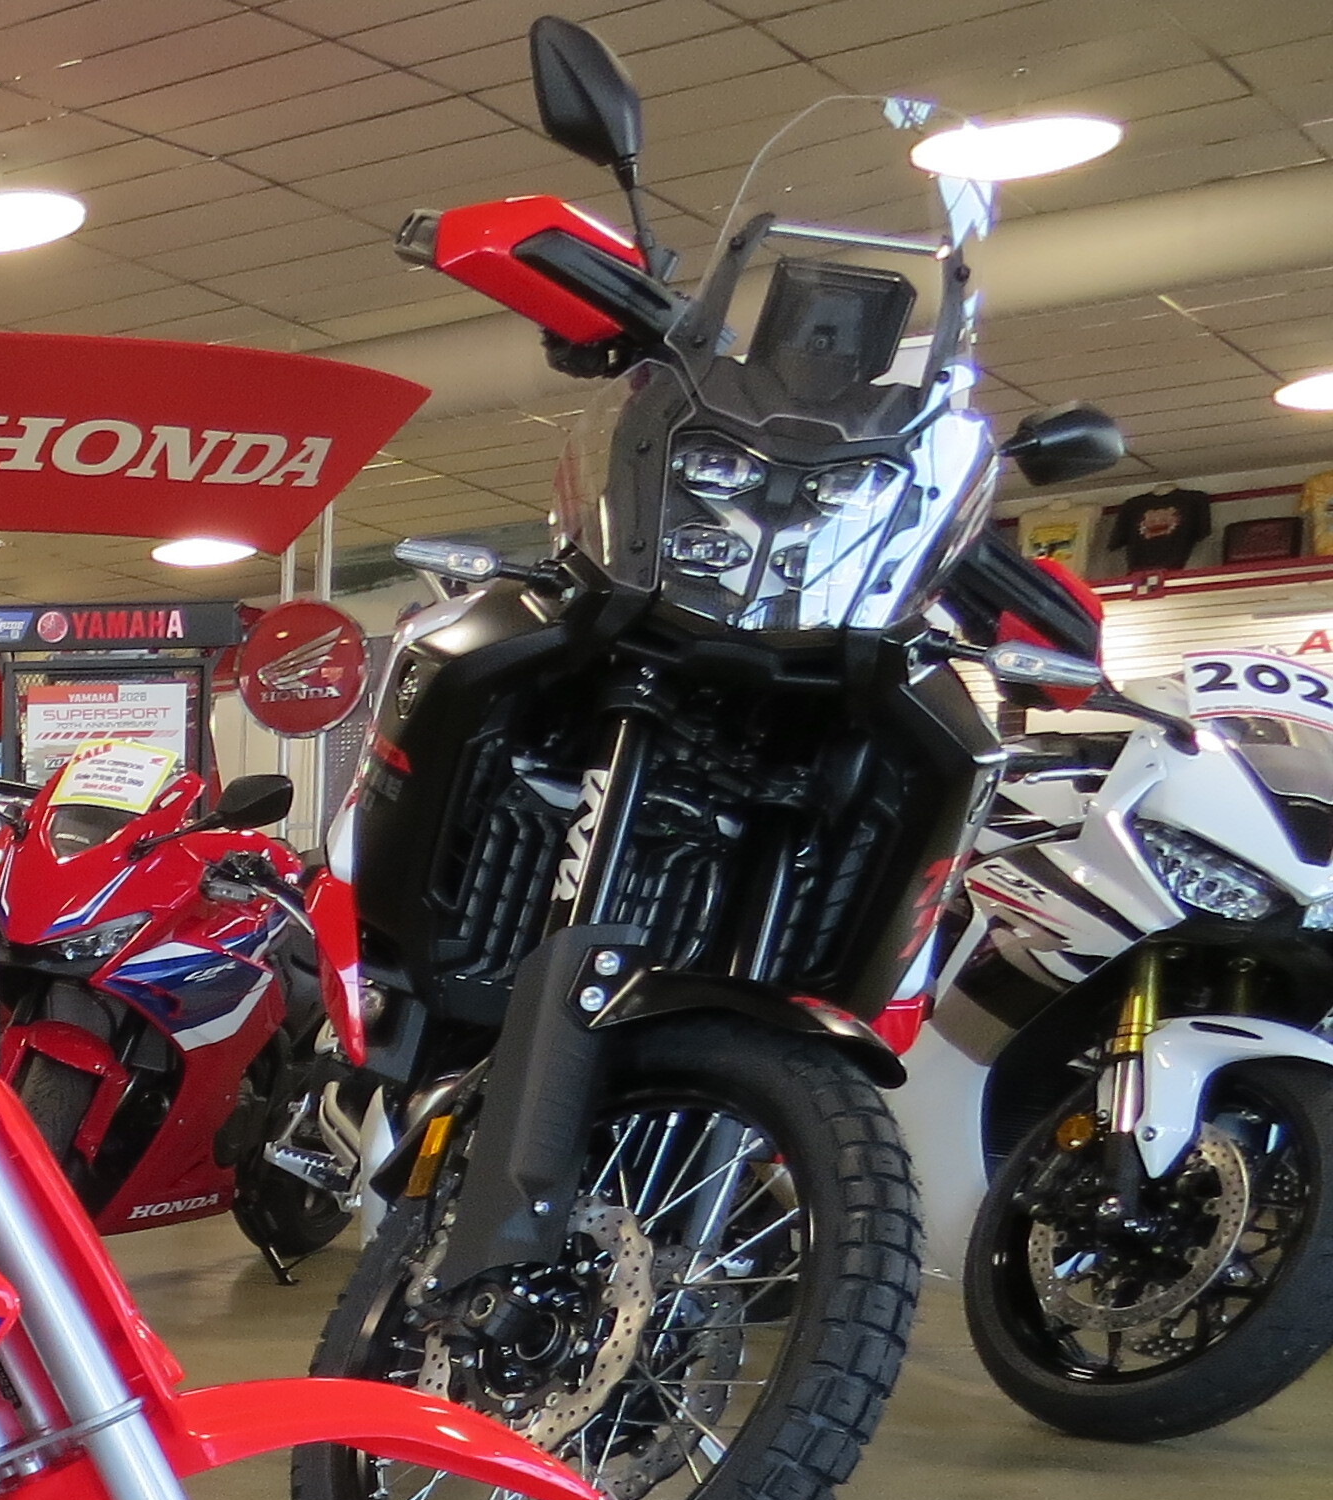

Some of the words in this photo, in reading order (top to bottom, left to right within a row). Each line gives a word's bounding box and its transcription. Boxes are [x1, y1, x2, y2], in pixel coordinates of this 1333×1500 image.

[72, 610, 185, 639] YAMAHA
[259, 686, 342, 703] HONDA
[1192, 660, 1333, 711] 202
[67, 693, 116, 703] YAMAHA
[42, 707, 171, 722] SUPERSPORT
[74, 742, 113, 764] SALE
[126, 1192, 220, 1220] HONDA
